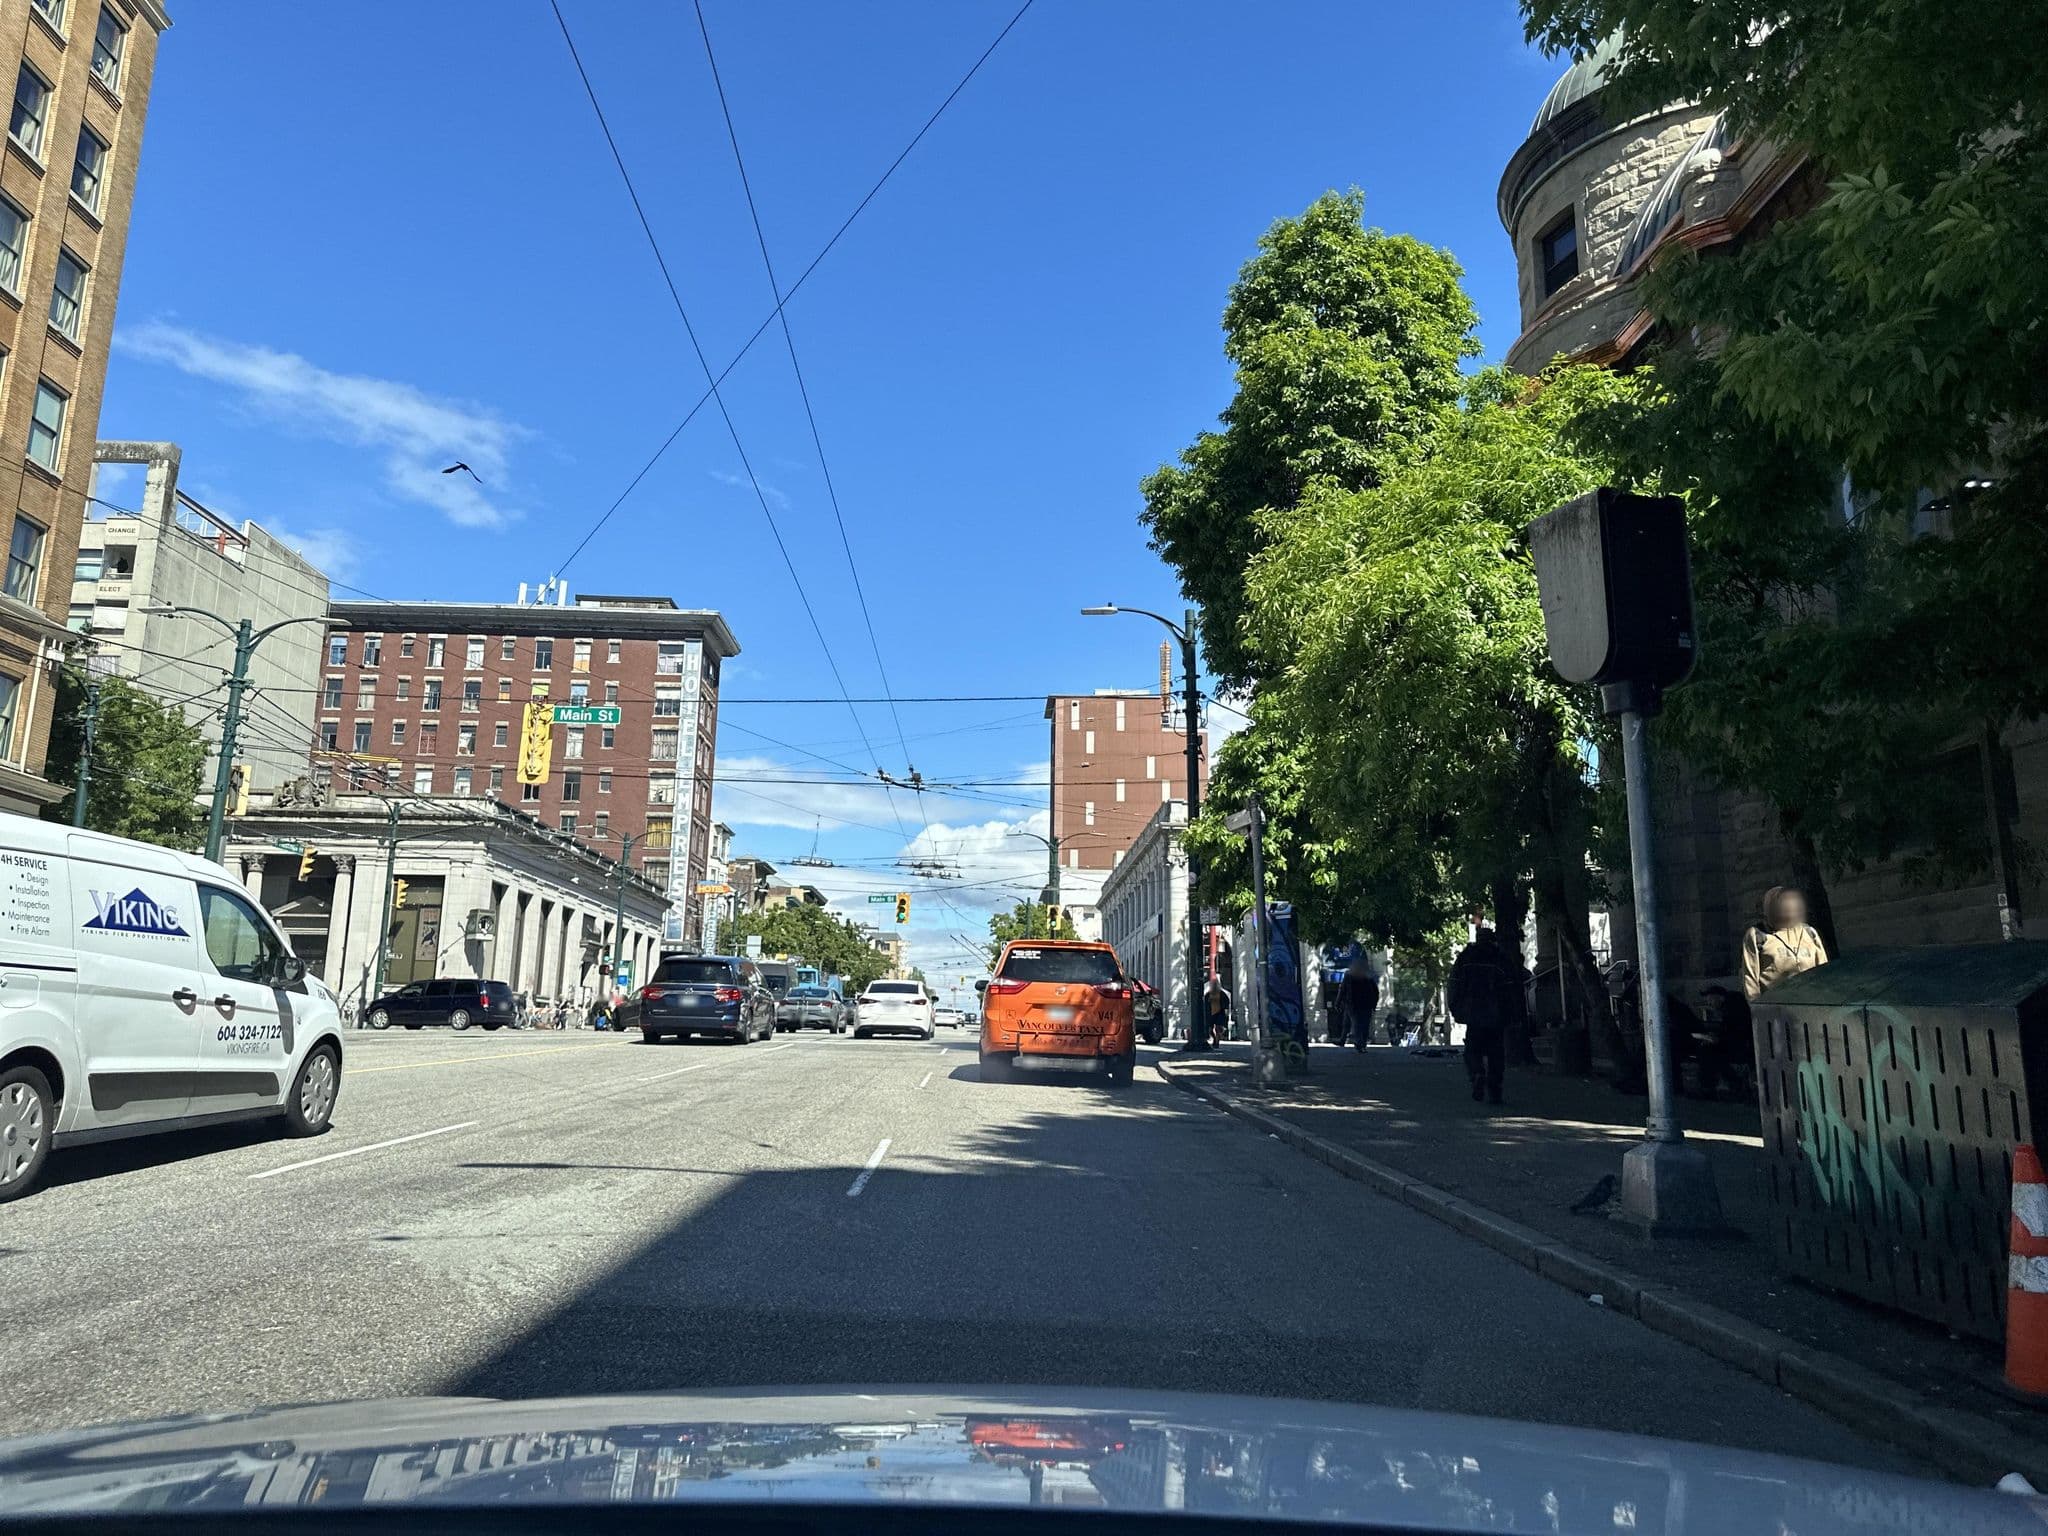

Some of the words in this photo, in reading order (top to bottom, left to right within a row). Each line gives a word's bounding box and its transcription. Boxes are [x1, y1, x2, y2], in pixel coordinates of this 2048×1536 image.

[680, 653, 699, 757] HOTEL
[560, 709, 592, 721] Main
[598, 709, 613, 721] St
[668, 770, 692, 919] EMPRESS
[14, 856, 48, 871] SERVICE
[26, 872, 49, 886] Design
[15, 884, 50, 897] Installation
[18, 898, 50, 910] Inspection
[88, 889, 179, 930] VIKING
[8, 910, 50, 924] Maintenance
[17, 924, 30, 935] Fire
[31, 926, 50, 937] Alarm
[132, 933, 176, 942] PROTECTION
[1098, 1011, 1114, 1021] V41
[217, 1025, 236, 1041] 604
[239, 1024, 282, 1041] 324-7122
[1017, 1019, 1077, 1031] VANCOUVER
[1077, 1024, 1105, 1034] TAXI
